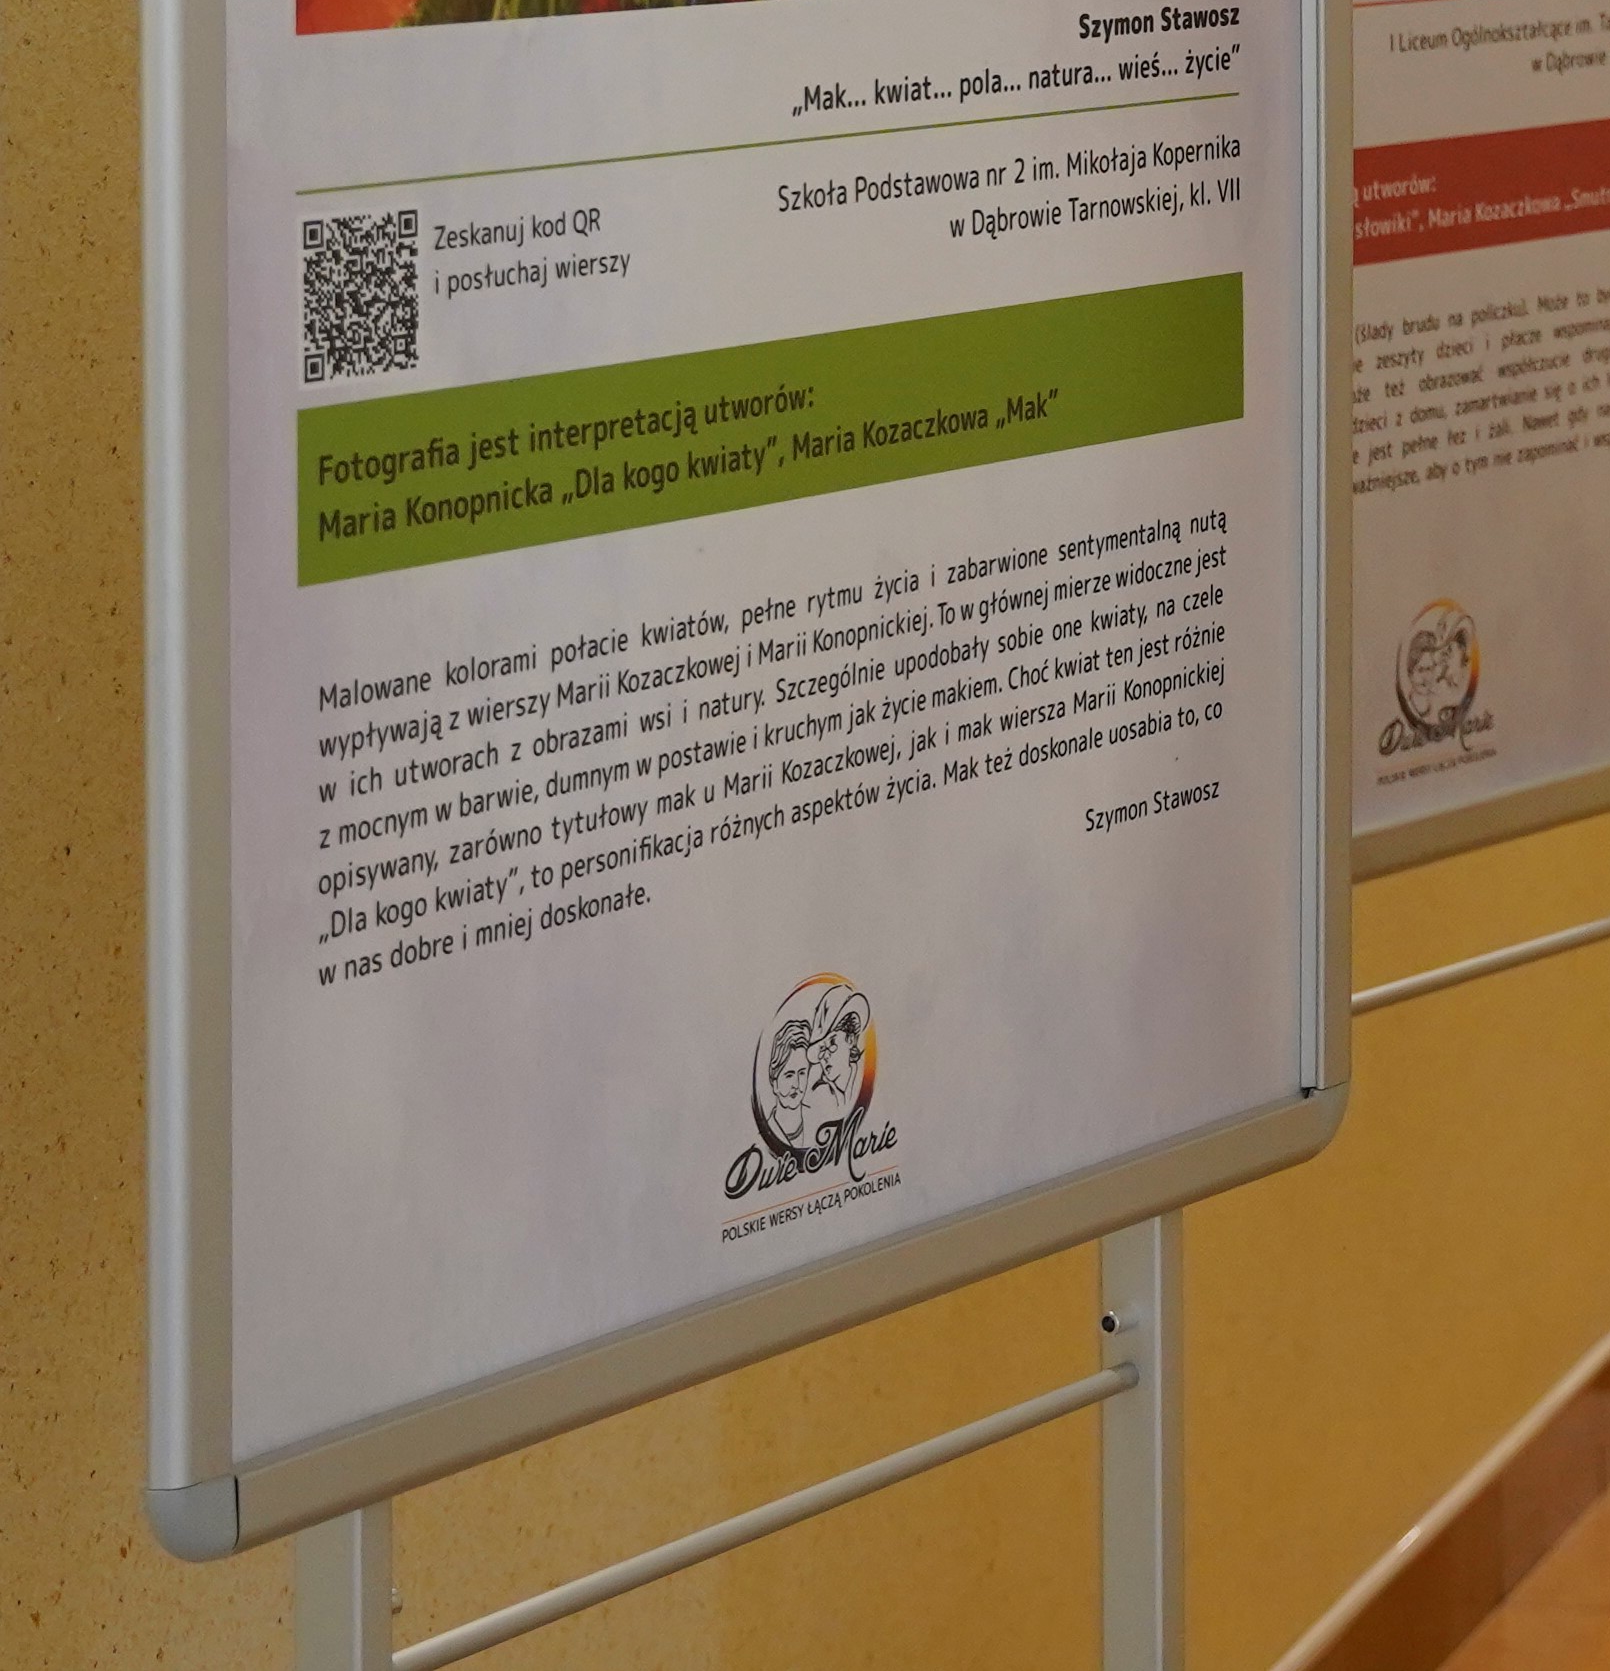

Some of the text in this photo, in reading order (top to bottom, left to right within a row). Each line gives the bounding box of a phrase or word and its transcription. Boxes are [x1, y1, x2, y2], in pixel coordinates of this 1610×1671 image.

[1078, 5, 1241, 45] Szymon Stawosz
[1398, 29, 1447, 51] Liceum
[1546, 45, 1605, 76] Dąbrowie
[776, 133, 1241, 214] Szkoła Podstawowa nr 2 im. Mikołaja Kopernika
[949, 175, 1241, 241] w Dąbrowie Tarnowskiej, kl. VII
[1428, 204, 1470, 229] Maria
[1475, 191, 1562, 221] Kozaczkowa
[432, 206, 602, 252] Zeskanuj kod QR
[433, 252, 632, 301] i posłuchaj wierszy
[316, 382, 815, 487] Fotografia jest interpretacją utworów:
[318, 500, 397, 543] Maria
[404, 476, 553, 528] Konopnicka
[622, 460, 681, 495] kogo
[791, 424, 856, 462] Maria
[862, 407, 989, 450] Kozaczkowa
[318, 508, 1228, 713] Malowane kolorami połacie kwiatów, pełne rytmu życia zabarwione sentymentalną nutą
[318, 543, 1228, 762] wypływają z wierszy Marii Kozaczkowej Marii Konopnickiej. To w głównej mierze widoczne jest
[317, 582, 1224, 804] w ich utworach z obrazami wsi natury. Szczególnie upodobały sobie one kwiaty, na czele
[318, 619, 1226, 851] z mocnym w barwie, dumnym w postawie kruchym jak życie makiem. Choć kwiat ten jest różnie
[316, 655, 1225, 900] opisywany, zarówno tytułowy mak u Marii Kozaczkowej, jak mak wiersza Marii Konopnickiej
[374, 896, 428, 930] kogo
[529, 863, 555, 890] to
[559, 824, 704, 890] personifikacja
[709, 802, 786, 845] różnych
[790, 781, 881, 826] aspektów
[885, 767, 937, 805] życia.
[943, 754, 980, 787] Mak
[983, 745, 1014, 776] też
[1017, 725, 1104, 768] doskonale
[1107, 709, 1173, 746] uosabia
[1176, 705, 1200, 729] to,
[1203, 701, 1224, 723] co
[1084, 780, 1221, 834] Szymon Stawosz
[317, 881, 652, 987] w nas dobre mniej doskonałe.
[805, 1106, 898, 1182] Marie
[721, 1172, 902, 1244] POLSKIE WERSY ŁĄCZĄ POKOLENIA
